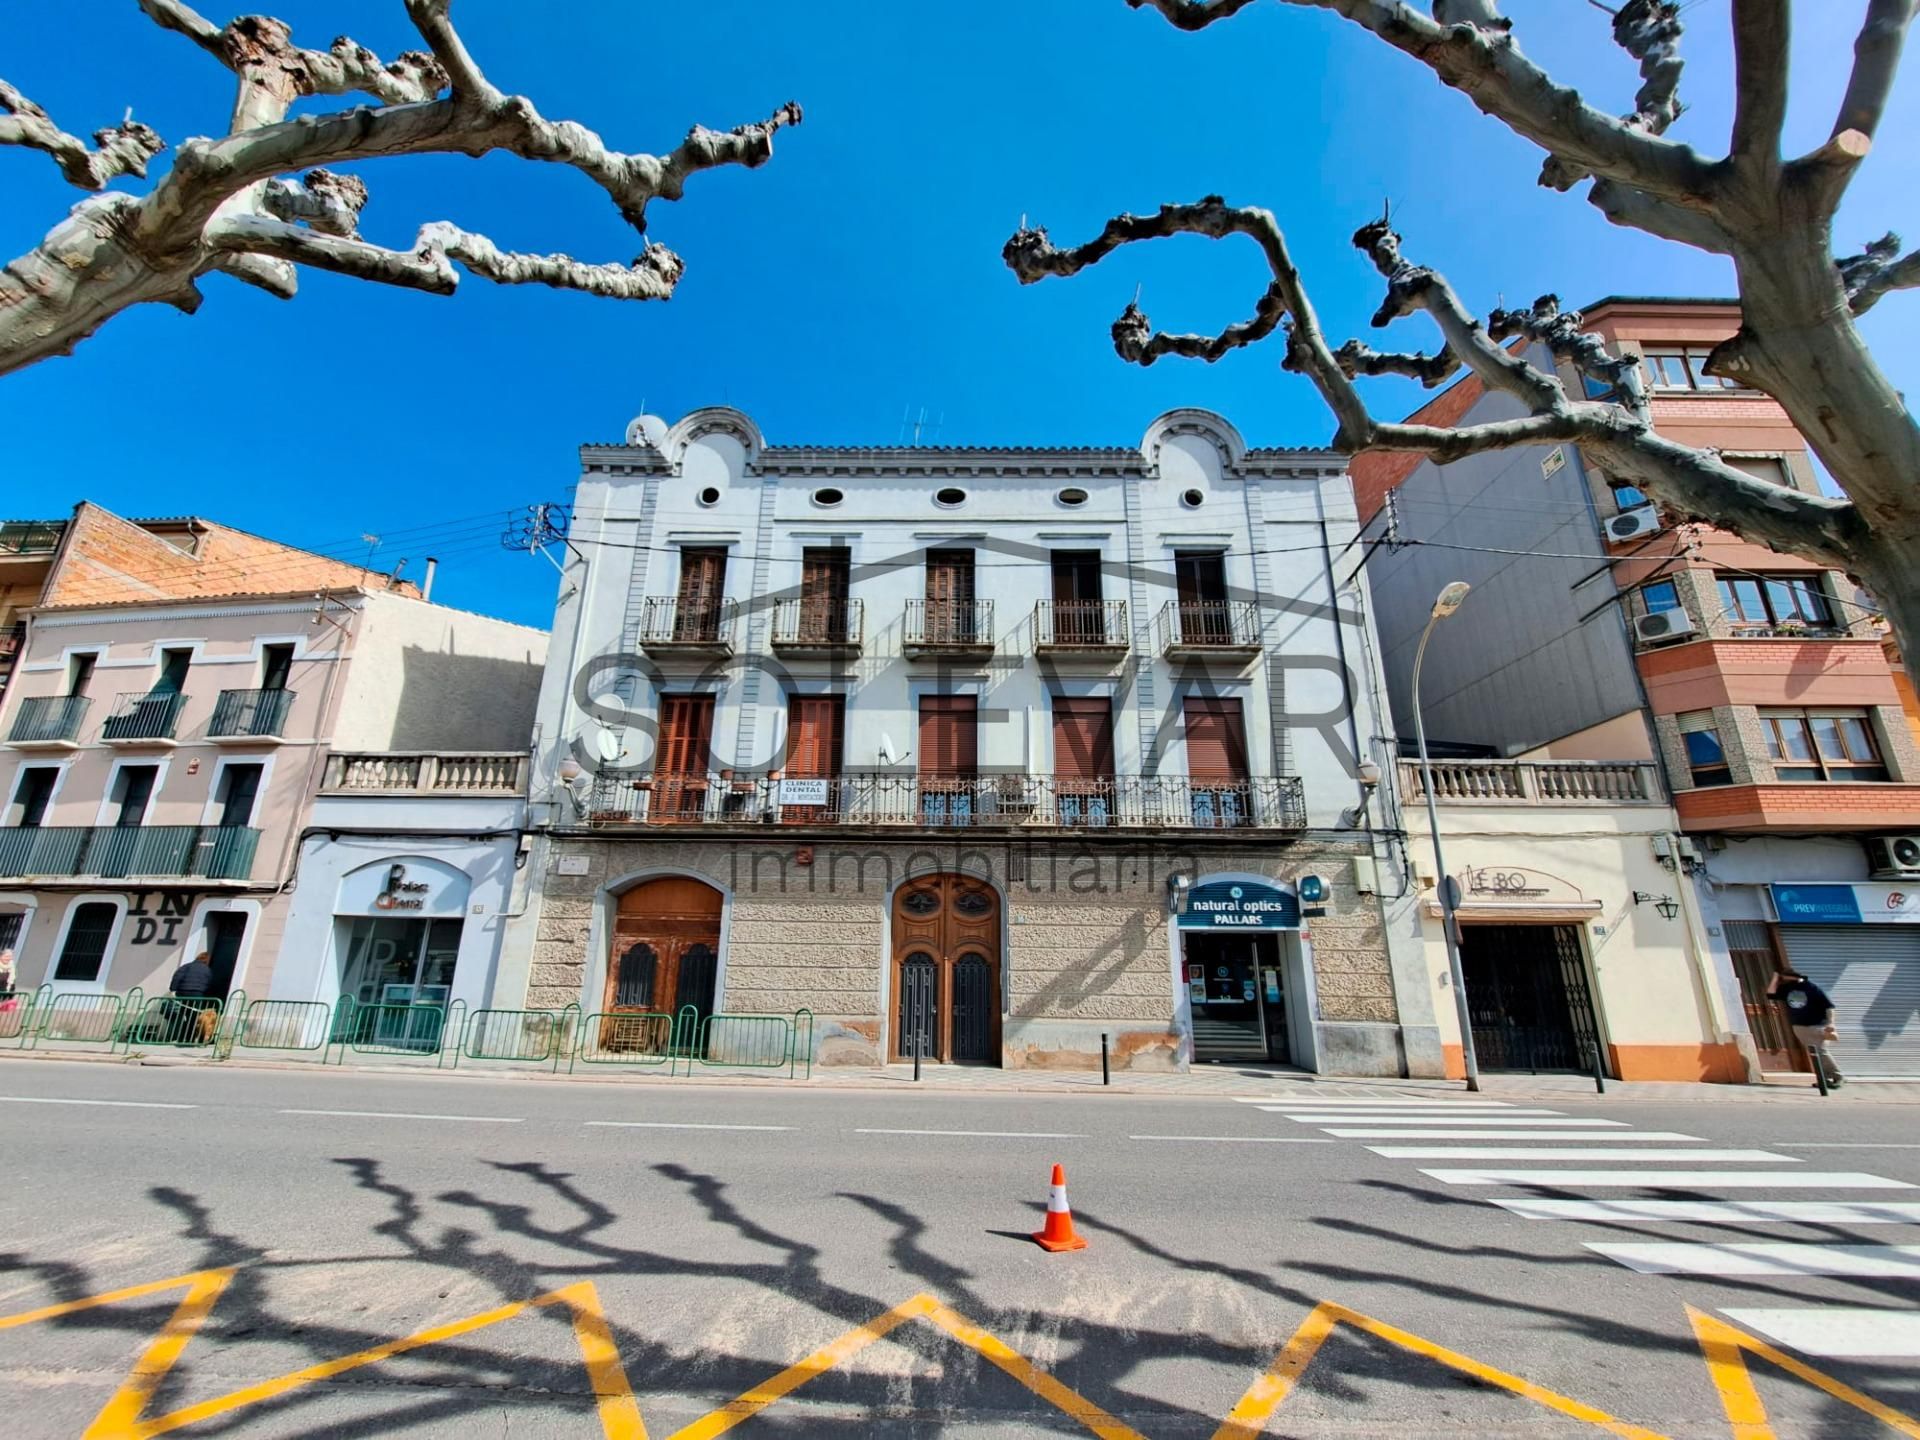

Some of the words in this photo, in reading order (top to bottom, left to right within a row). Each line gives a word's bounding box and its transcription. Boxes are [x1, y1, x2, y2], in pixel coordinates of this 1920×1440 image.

[1193, 900, 1240, 911] natural
[1243, 900, 1282, 914] optics
[1214, 914, 1263, 925] PALLARS
[130, 917, 184, 945] DI
